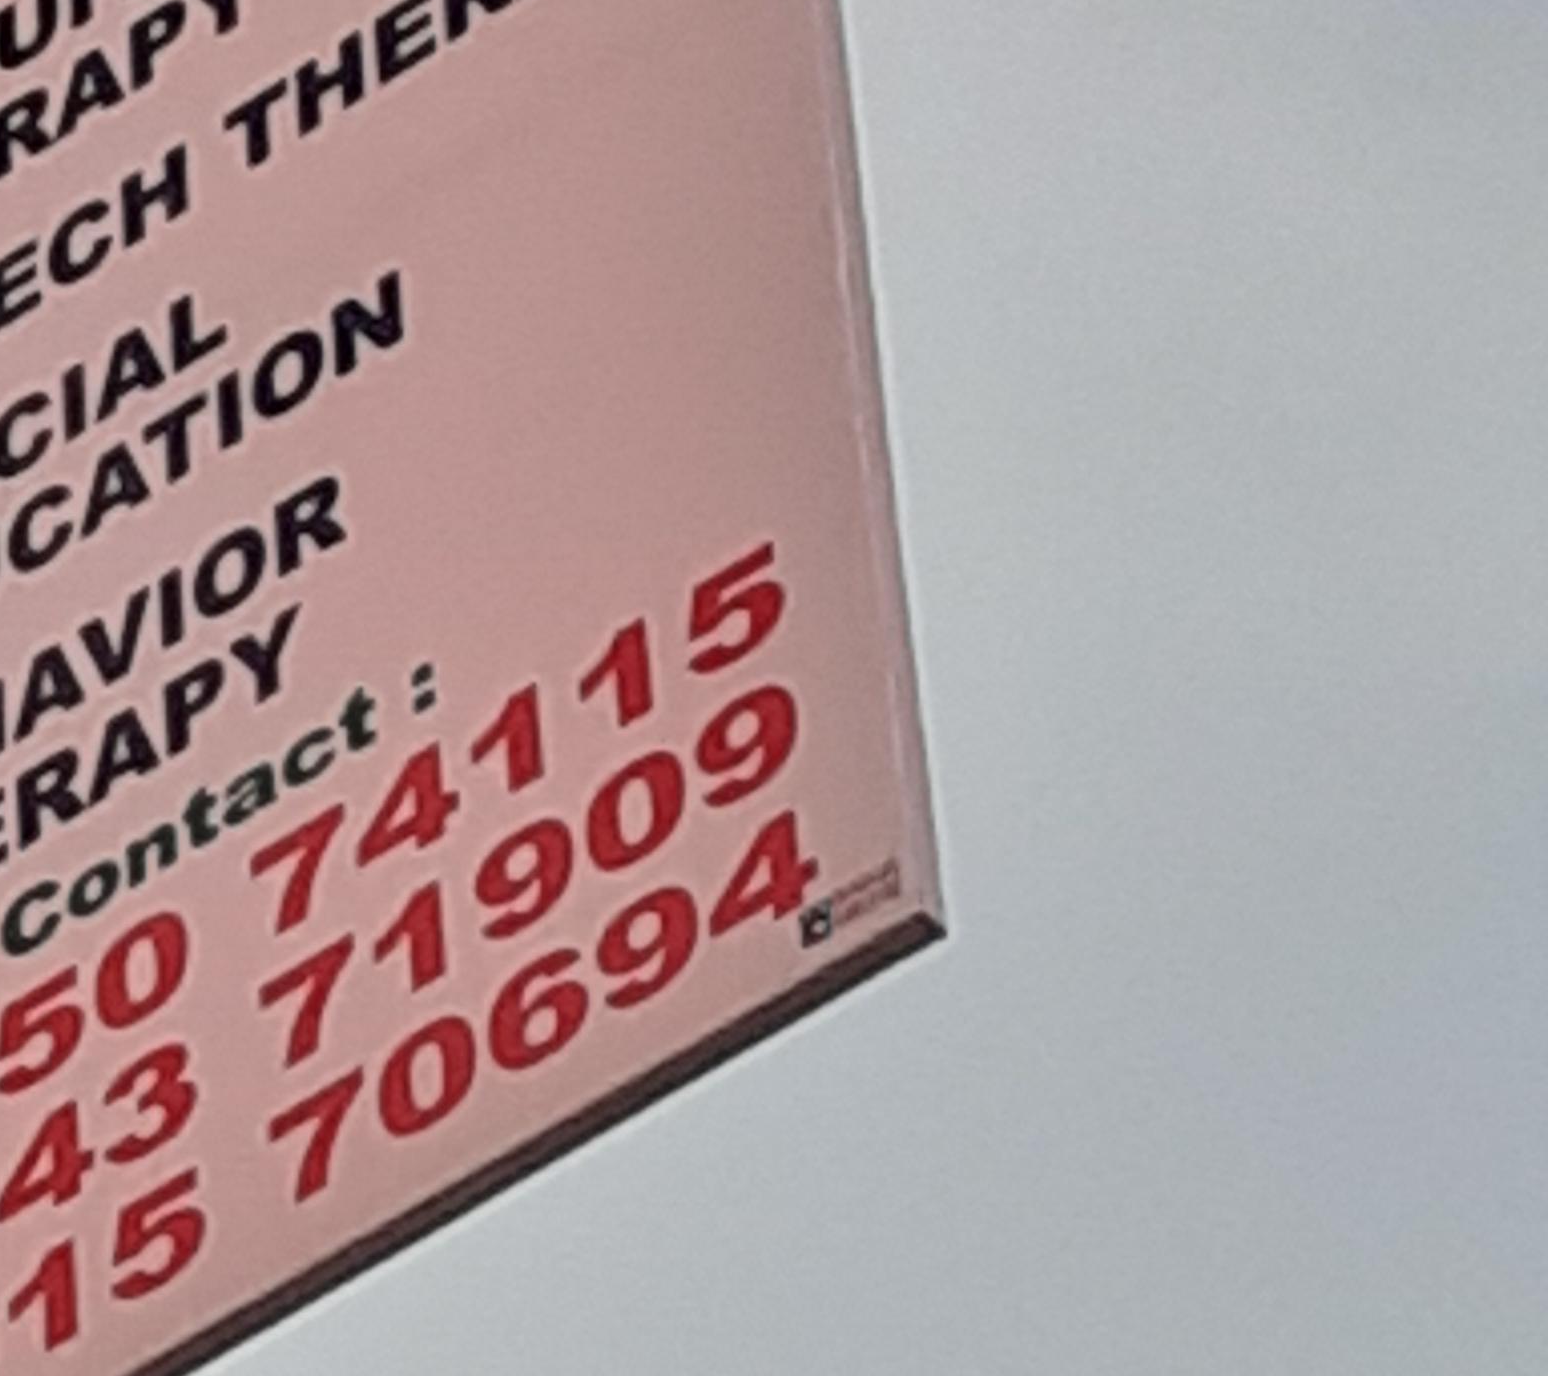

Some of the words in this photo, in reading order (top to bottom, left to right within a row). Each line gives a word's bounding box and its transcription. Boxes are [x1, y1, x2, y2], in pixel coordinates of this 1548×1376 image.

[0, 687, 378, 956] Contact
[252, 540, 786, 937] 74115
[257, 685, 799, 1068] 71909
[267, 811, 821, 1204] 70694
